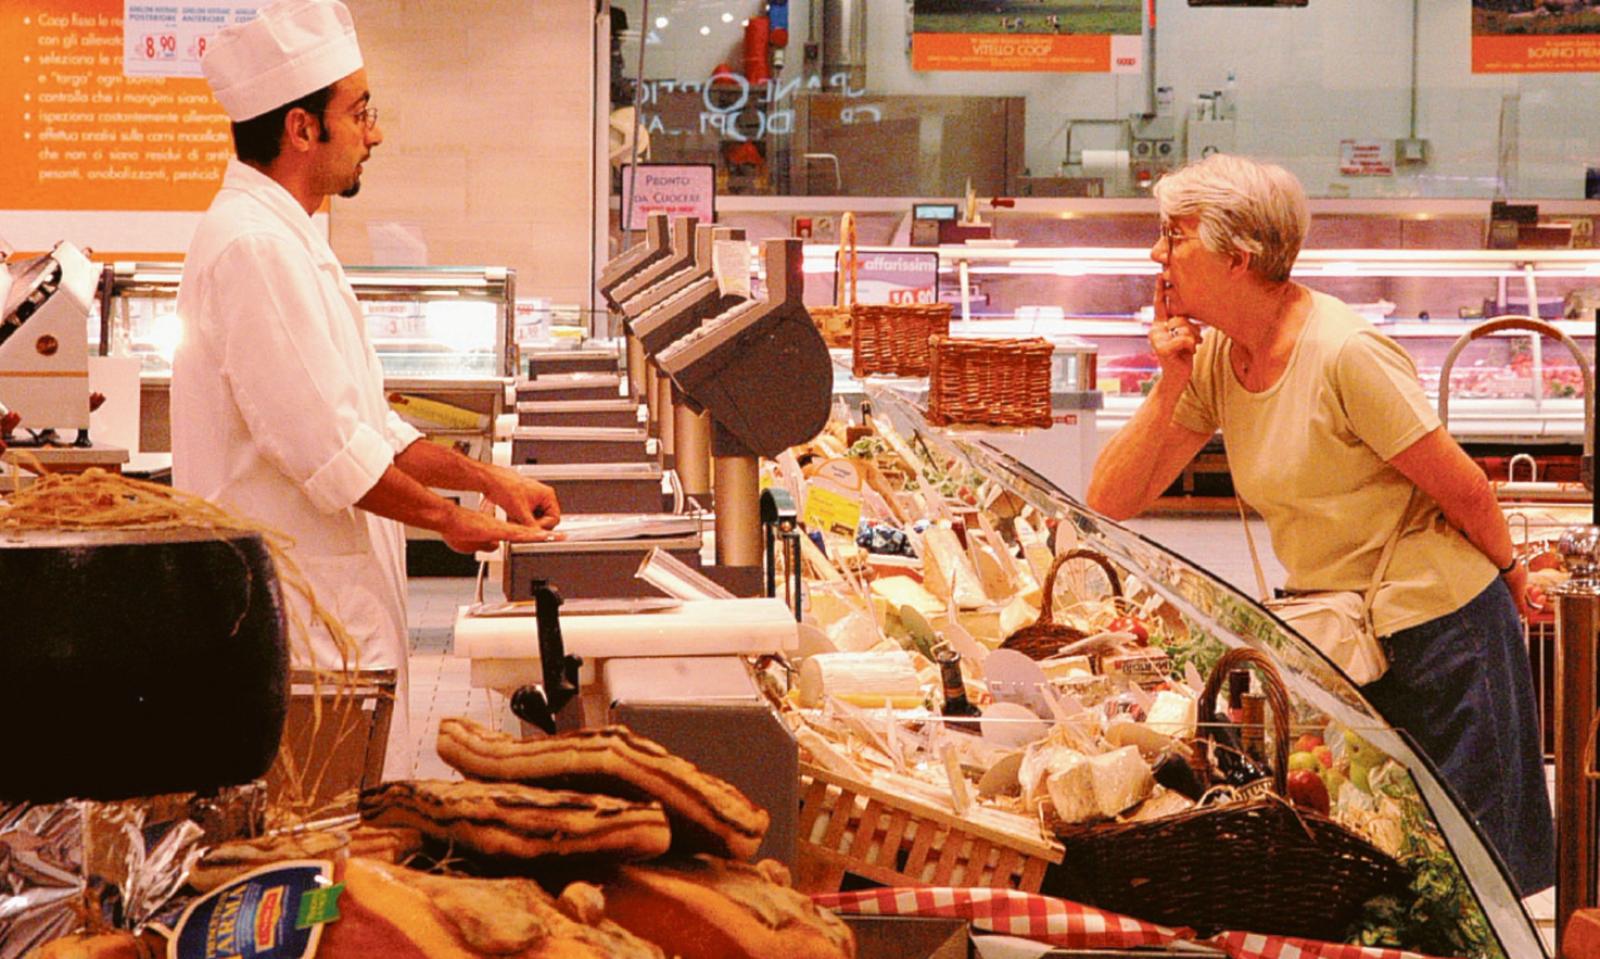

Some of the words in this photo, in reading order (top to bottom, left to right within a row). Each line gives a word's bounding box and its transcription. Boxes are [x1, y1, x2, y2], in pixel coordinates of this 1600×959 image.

[38, 12, 70, 29] Coop
[98, 12, 110, 27] le
[38, 35, 60, 46] con
[63, 31, 78, 49] gli
[38, 50, 95, 65] seleziona
[99, 51, 110, 65] le
[972, 44, 1014, 56] VITELLO
[1017, 44, 1052, 56] COOP
[38, 74, 47, 84] e
[96, 70, 122, 88] ogni
[38, 88, 89, 104] controlla
[92, 89, 114, 104] che
[123, 91, 174, 108] mangimi
[177, 91, 209, 104] siano
[38, 107, 95, 125] ispeziona
[98, 109, 178, 123] costantemente
[38, 126, 79, 142] effettua
[81, 127, 117, 142] analisi
[120, 127, 144, 143] sulle
[147, 130, 175, 143] carni
[177, 128, 229, 143] macellate
[38, 146, 59, 161] che
[64, 150, 87, 161] non
[109, 147, 139, 161] siano
[145, 147, 181, 162] residui
[187, 147, 199, 162] di
[172, 166, 220, 184] pesticidi
